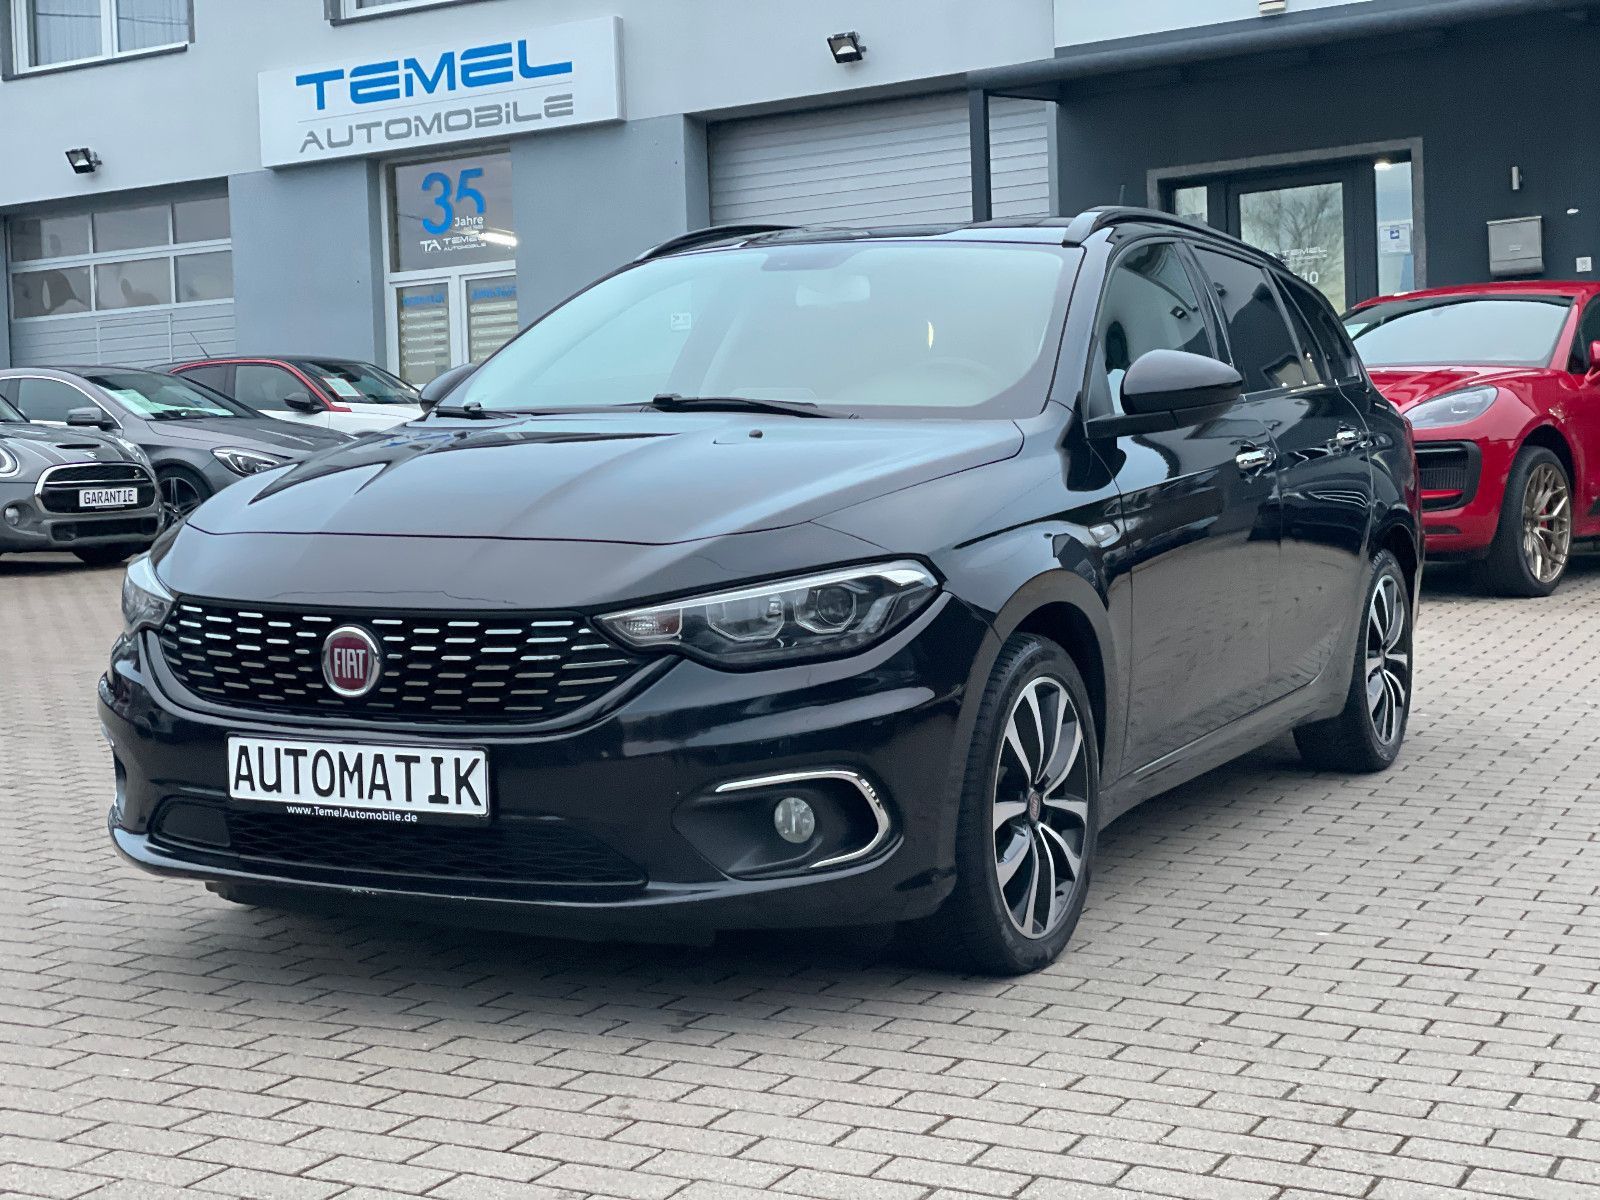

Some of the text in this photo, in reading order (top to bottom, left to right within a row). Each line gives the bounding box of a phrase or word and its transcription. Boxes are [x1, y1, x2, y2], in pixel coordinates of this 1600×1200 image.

[296, 39, 573, 110] TEMEL
[421, 167, 487, 235] 35
[454, 215, 484, 227] Jahre
[83, 489, 134, 505] GARANTIE
[333, 648, 366, 680] FIAT
[234, 745, 482, 806] AUTOMATIK
[286, 805, 418, 823] www.TemelAutomobile.de
